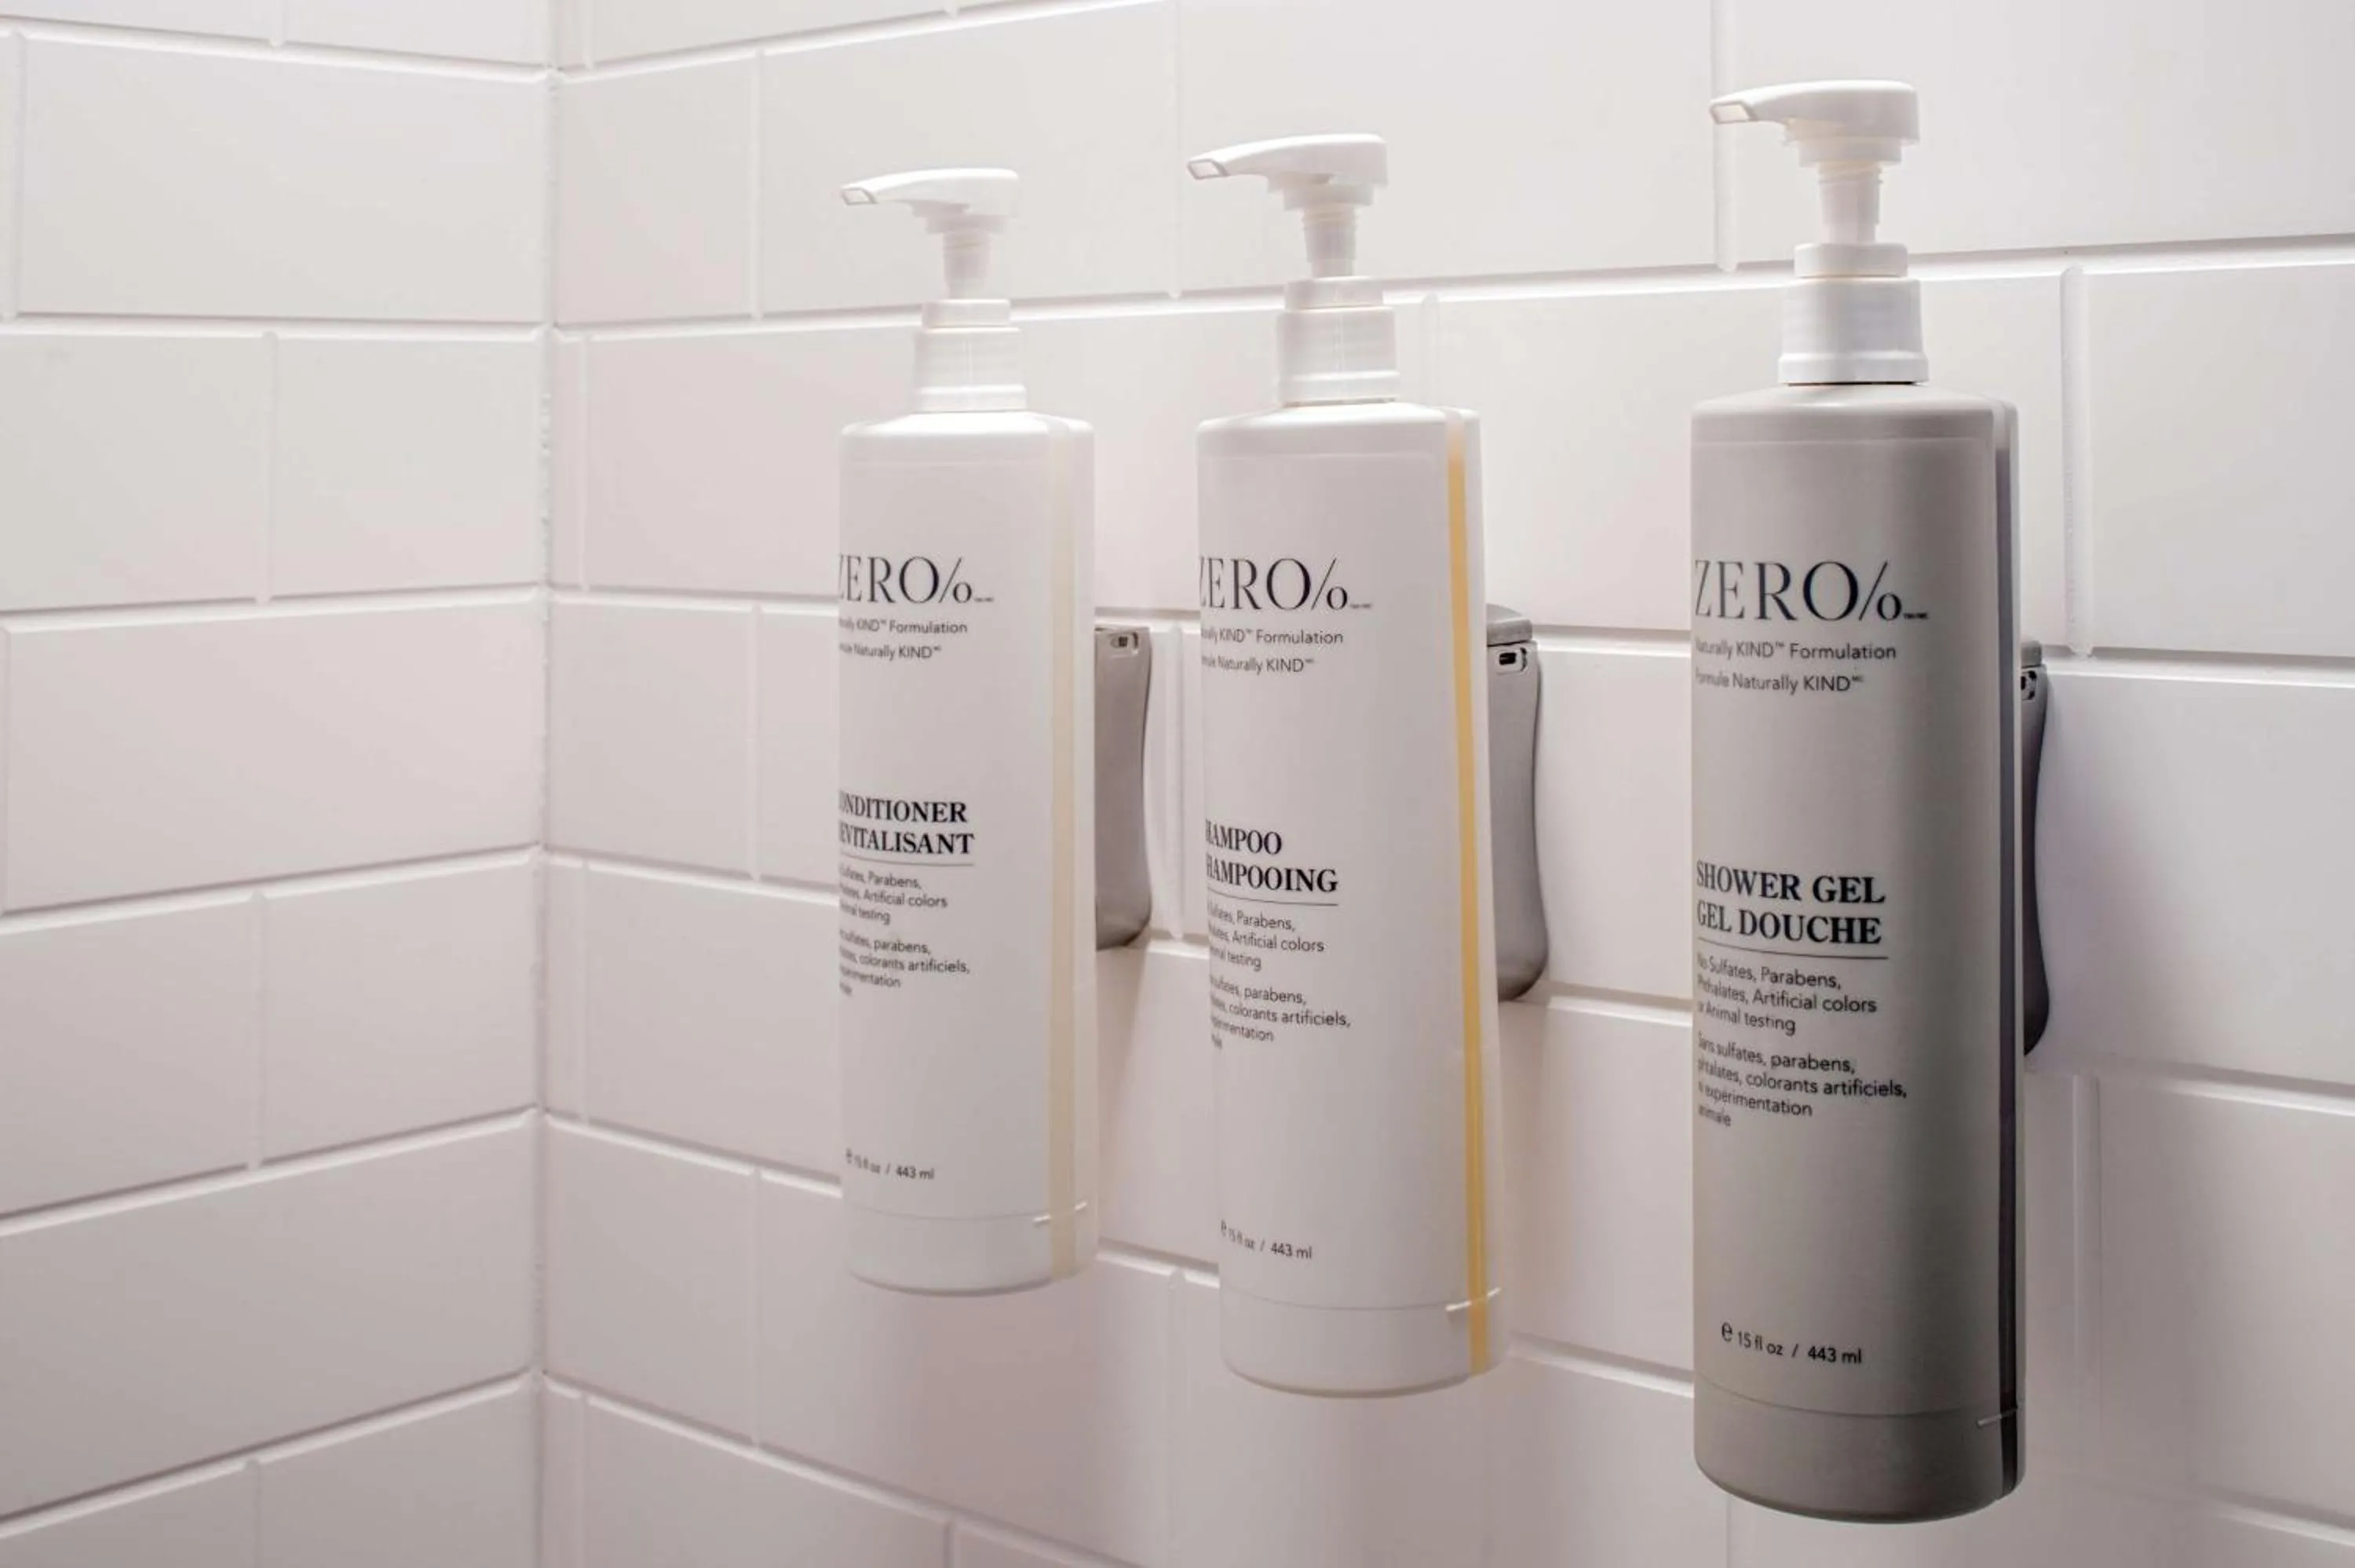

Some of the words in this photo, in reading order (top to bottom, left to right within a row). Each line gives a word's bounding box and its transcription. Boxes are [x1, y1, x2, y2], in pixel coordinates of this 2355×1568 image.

[889, 619, 968, 634] Formulation
[1256, 629, 1344, 644] Formulation
[1790, 642, 1897, 660] Formulation
[1732, 672, 1798, 696] Naturally
[1696, 859, 1802, 901] SHOWER
[1813, 875, 1886, 903] GEL
[907, 894, 948, 908] colors
[859, 908, 891, 926] testing
[1236, 910, 1296, 932] Parabens,
[1697, 900, 1732, 933] GEL
[1737, 909, 1882, 944] DOUCHE
[1232, 930, 1278, 950] Artificial
[1280, 936, 1325, 953] colors
[907, 957, 971, 975] artificiels,
[1227, 950, 1262, 972] testing
[1709, 955, 1757, 982] Sulfates,
[1761, 965, 1842, 990] Parabens,
[1244, 986, 1307, 1006] parabens,
[1752, 987, 1818, 1011] Artificial
[1822, 995, 1878, 1013] colors
[1229, 1001, 1278, 1023] colorants
[1280, 1009, 1352, 1029] artificiels,
[1744, 1012, 1796, 1037] testing
[1717, 1041, 1766, 1067] sulfates,
[1771, 1052, 1855, 1075] parabens,
[1746, 1071, 1819, 1095] colorants
[1823, 1077, 1908, 1099] artificiels,
[1705, 1083, 1813, 1118] experimentation
[896, 1165, 916, 1180] 443
[918, 1167, 935, 1180] ml
[1270, 1242, 1293, 1257] 443
[1296, 1245, 1313, 1260] ml
[1737, 1330, 1752, 1349] 15
[1766, 1343, 1784, 1355] oz
[1807, 1346, 1838, 1364] 443
[1841, 1347, 1863, 1365] ml
